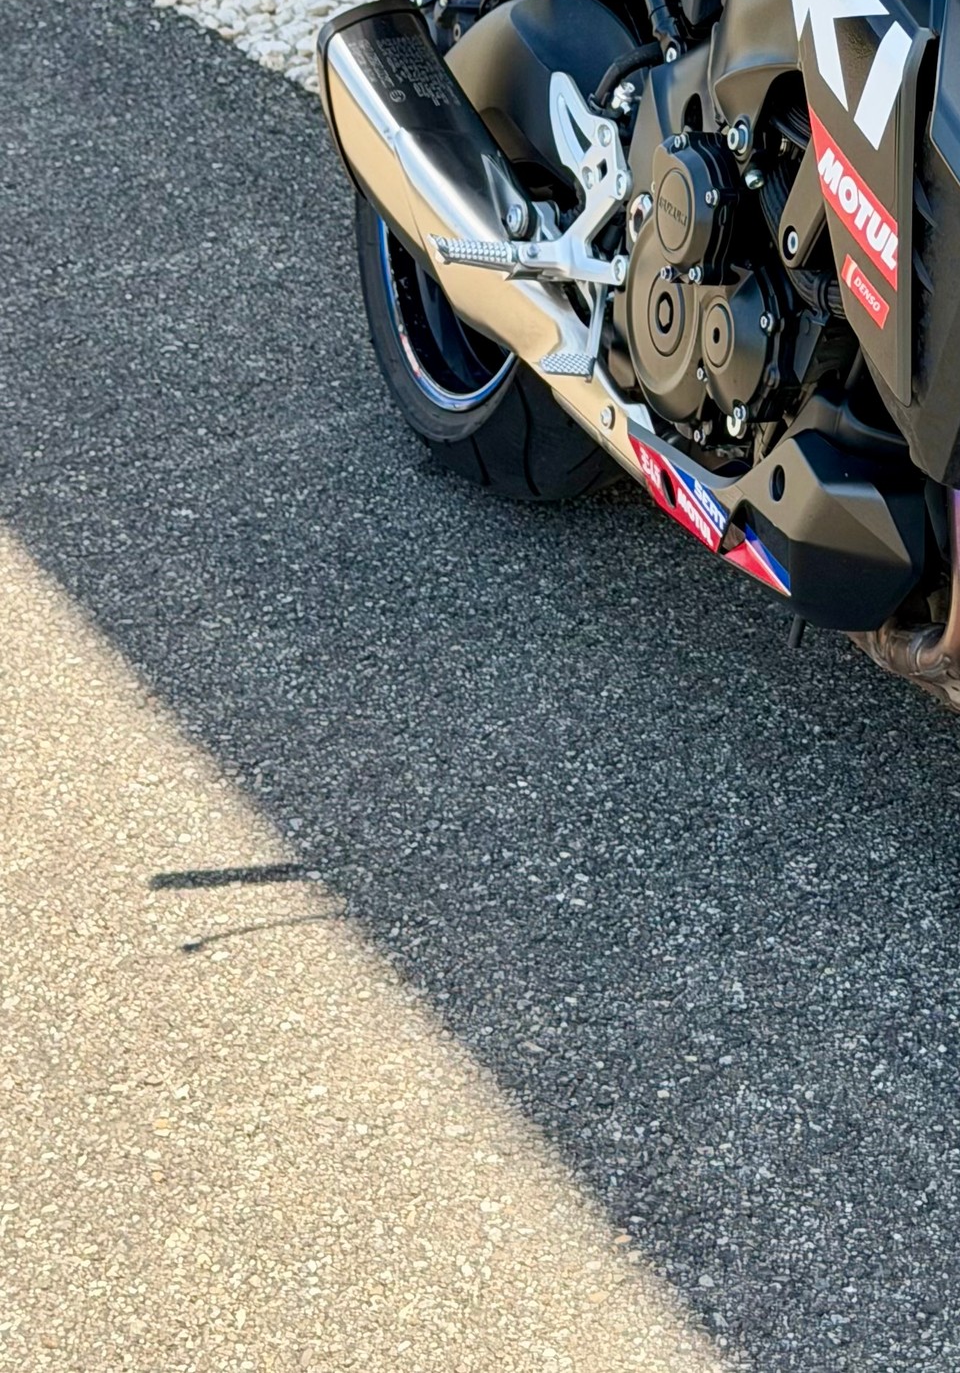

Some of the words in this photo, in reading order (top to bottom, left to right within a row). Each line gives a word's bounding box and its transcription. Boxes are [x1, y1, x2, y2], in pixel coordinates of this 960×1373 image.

[817, 147, 899, 271] MOTUL
[853, 276, 881, 313] DENSO
[677, 490, 714, 547] MOTUL
